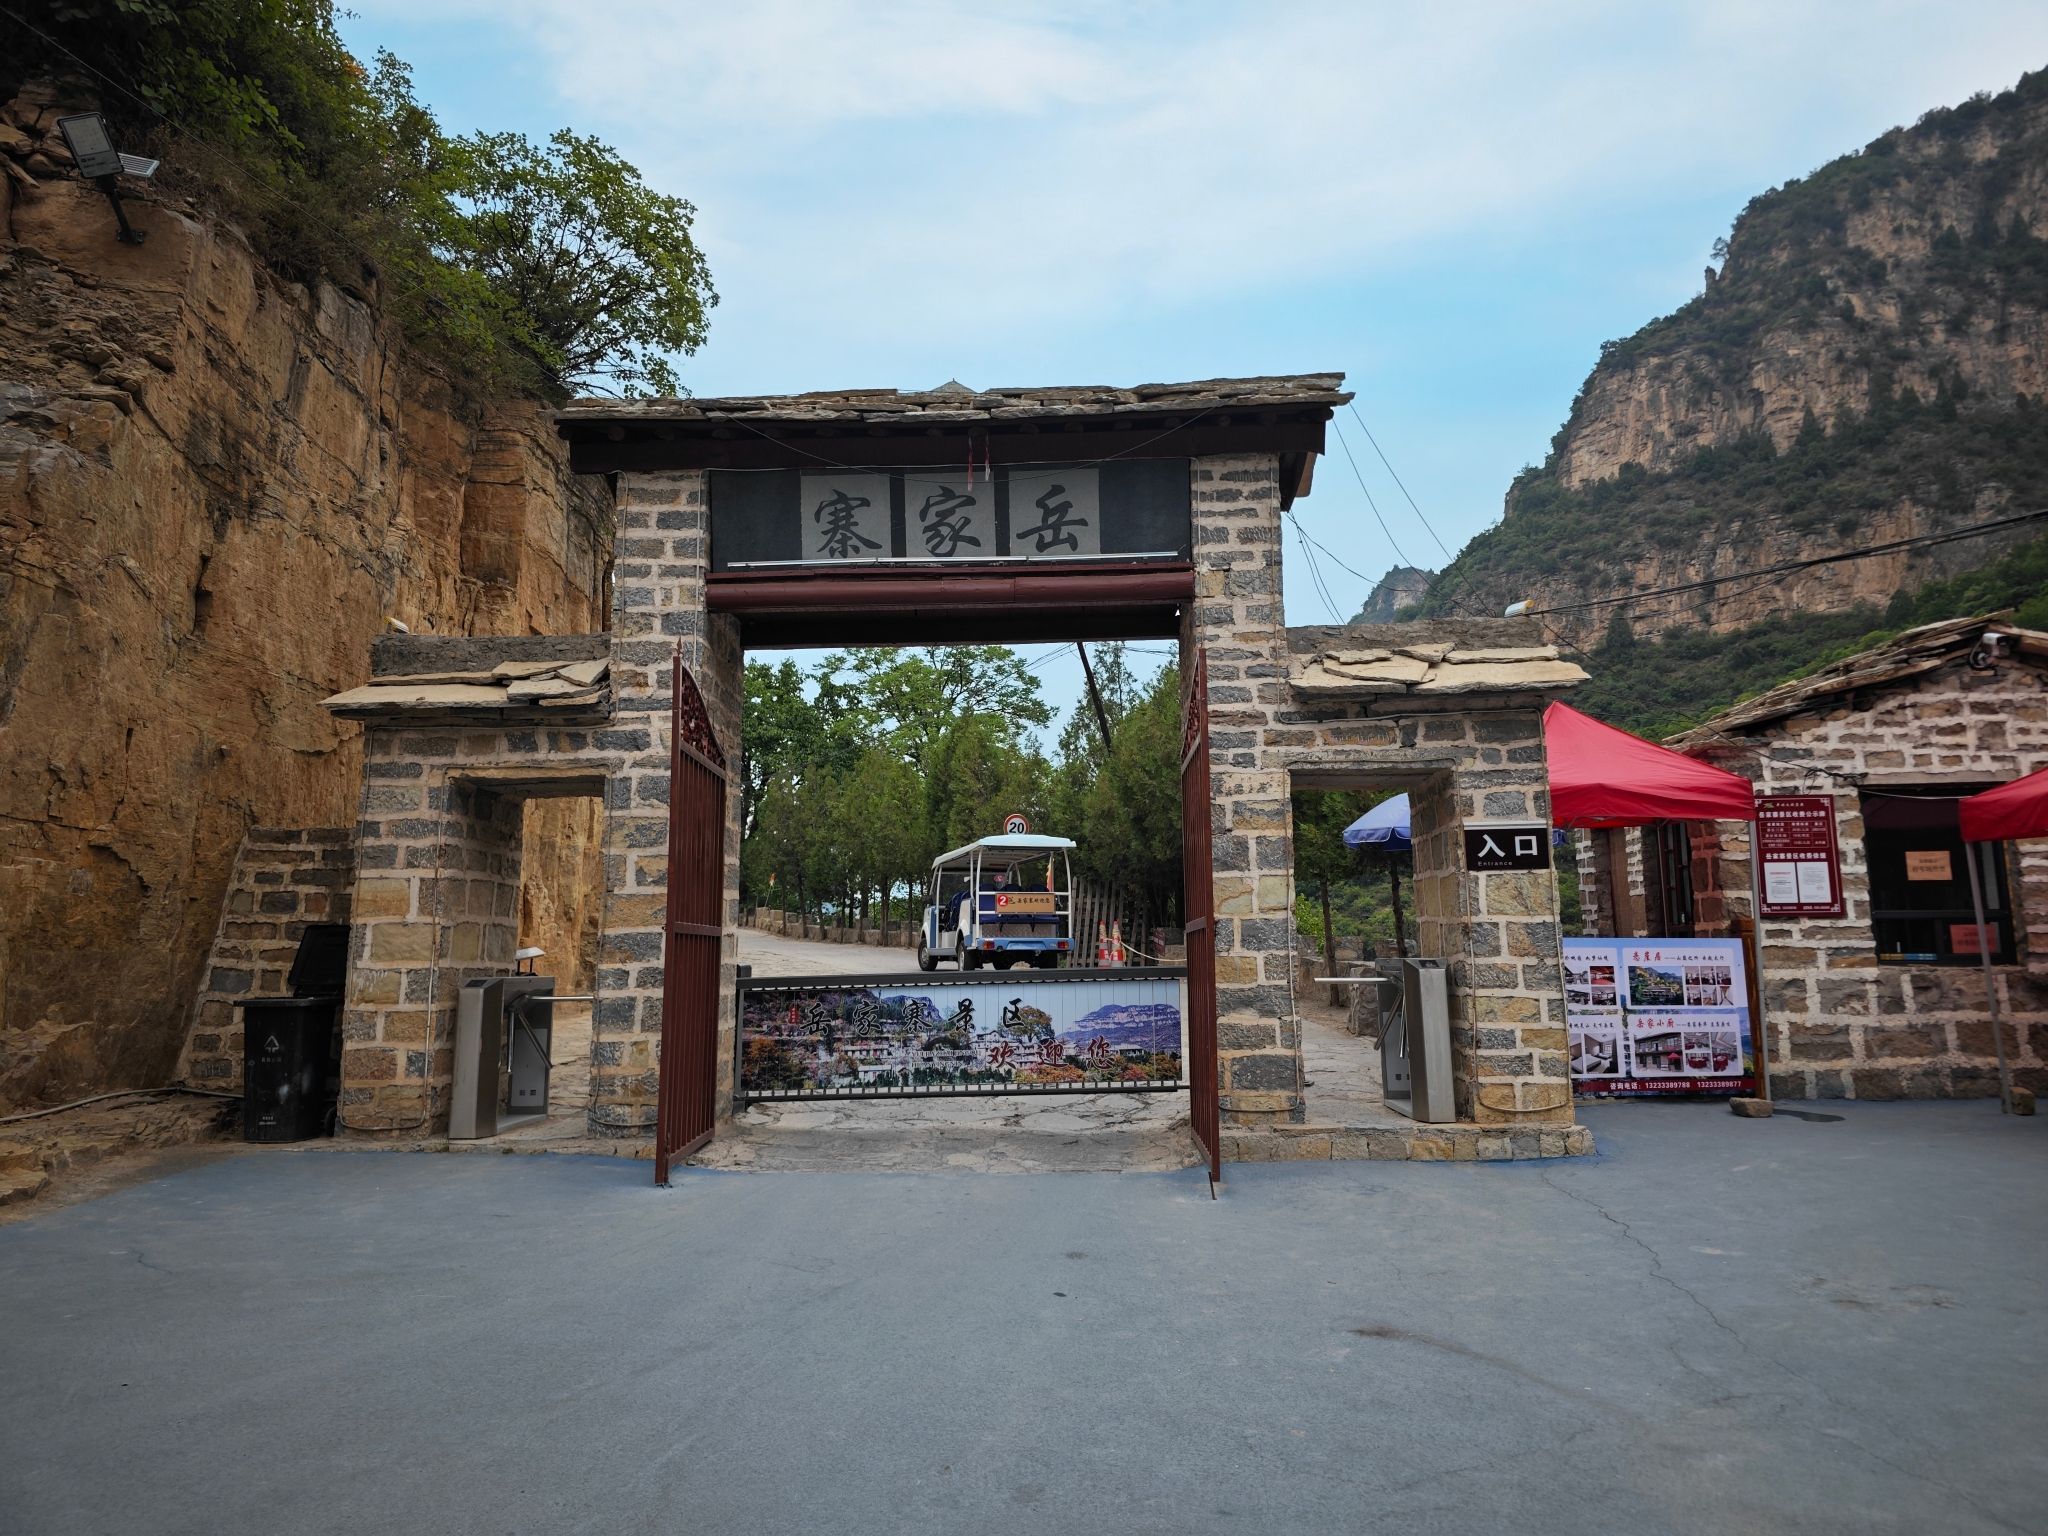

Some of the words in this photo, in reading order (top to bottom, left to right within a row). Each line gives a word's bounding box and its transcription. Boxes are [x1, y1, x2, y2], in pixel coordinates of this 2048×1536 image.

[1009, 822, 1024, 834] 20
[1477, 833, 1538, 858] 入口
[999, 895, 1007, 906] 2
[799, 997, 1025, 1037] 岳家寨景区
[987, 1035, 1116, 1072] 欢迎您
